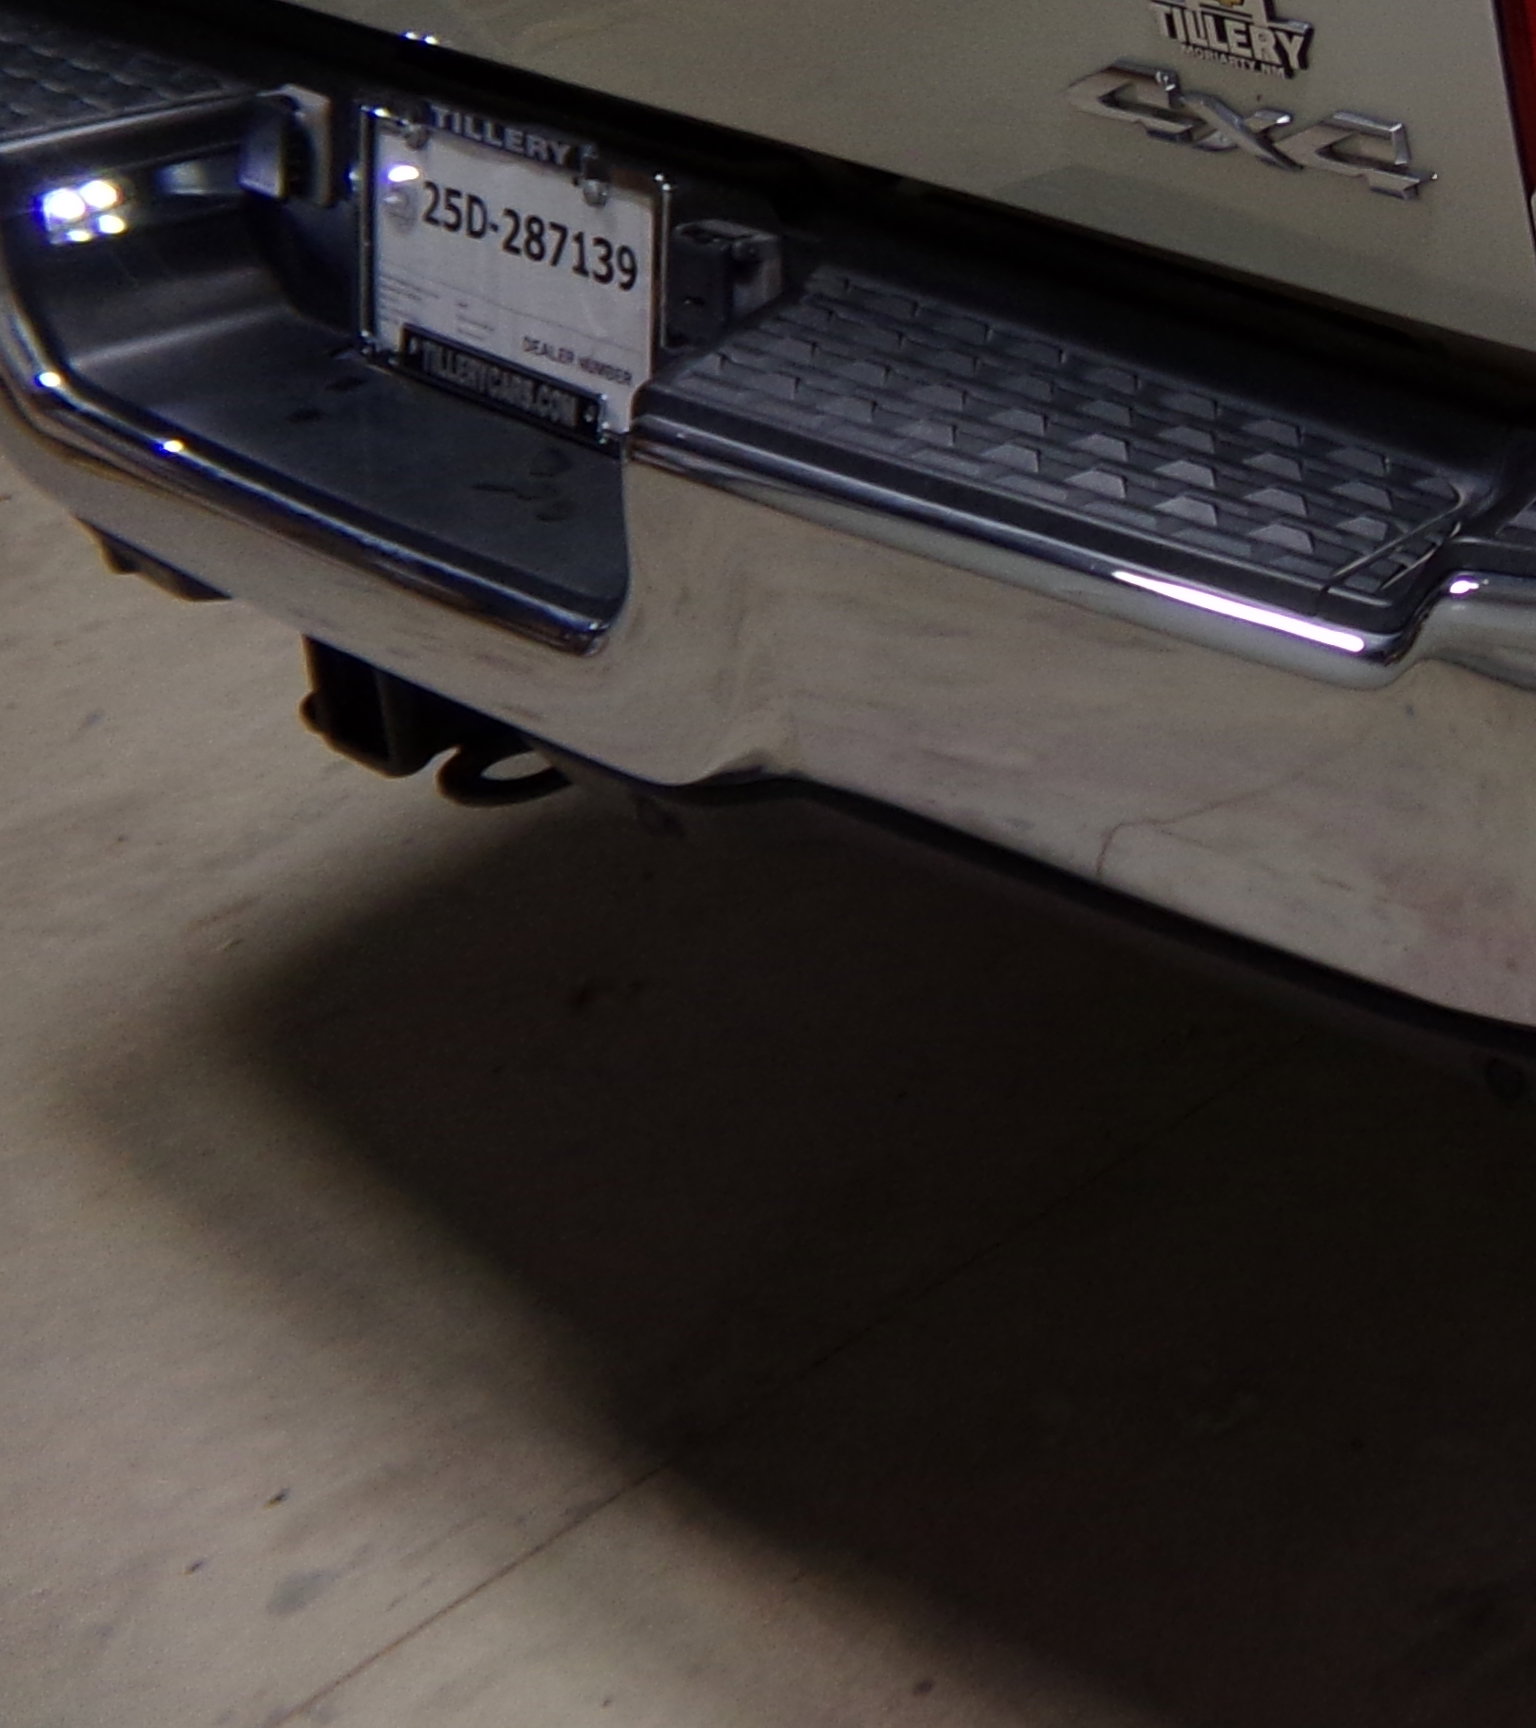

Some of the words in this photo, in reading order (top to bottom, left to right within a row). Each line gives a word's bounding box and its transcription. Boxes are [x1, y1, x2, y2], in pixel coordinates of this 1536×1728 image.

[1151, 3, 1312, 70] TILLERY
[430, 105, 573, 165] TILLERY
[421, 180, 639, 292] 25D-287139
